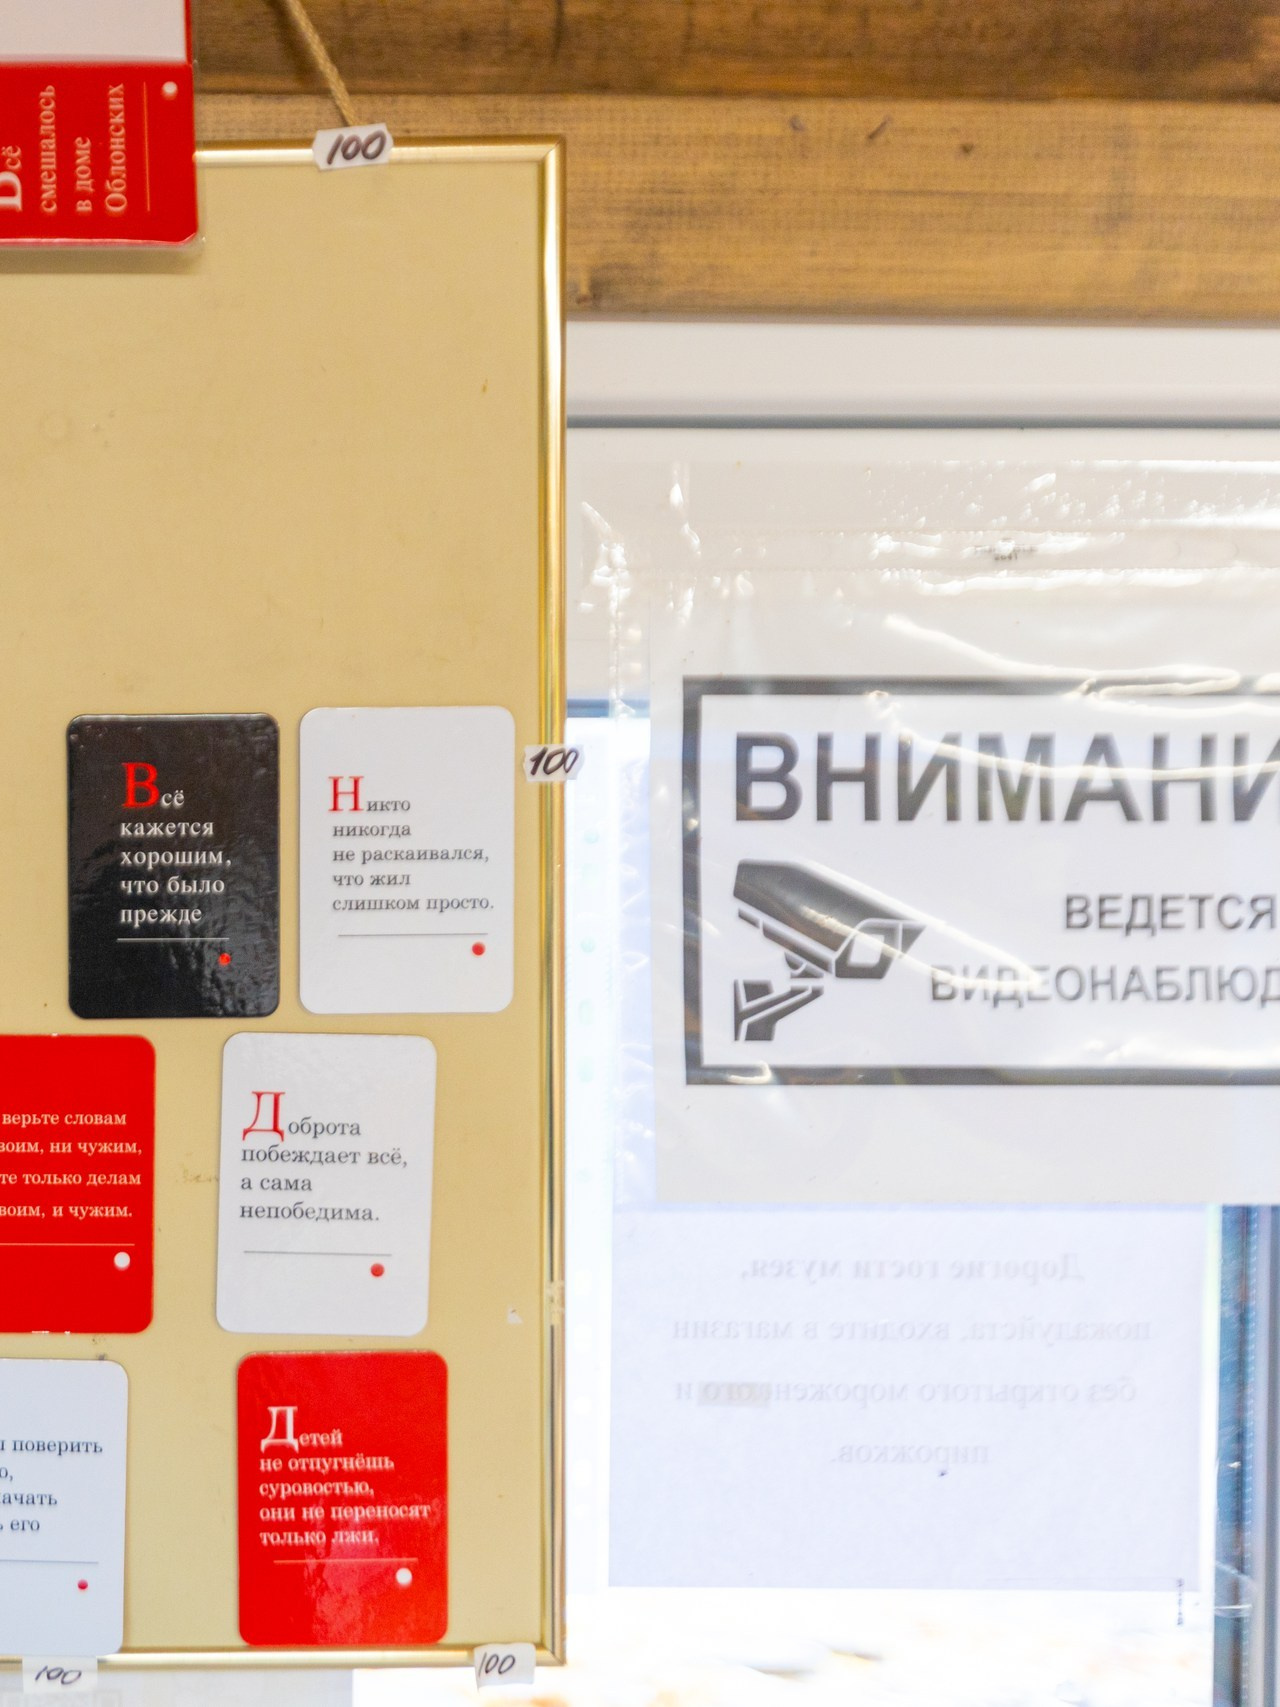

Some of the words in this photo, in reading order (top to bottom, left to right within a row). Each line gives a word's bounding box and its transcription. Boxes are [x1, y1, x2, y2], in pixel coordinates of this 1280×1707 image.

[40, 85, 56, 213] смешалось
[105, 83, 128, 214] Облонских
[327, 130, 386, 165] 100
[75, 136, 92, 193] доме
[76, 199, 92, 213] в
[530, 747, 579, 775] 100
[121, 762, 185, 809] Всё
[328, 776, 411, 812] Никто
[120, 822, 214, 836] кажется
[333, 824, 411, 838] никогда
[120, 851, 232, 870] хорошим,
[333, 851, 355, 861] не
[361, 848, 489, 864] раскаивался,
[121, 879, 159, 893] что
[167, 876, 225, 893] было
[332, 875, 364, 886] что
[370, 874, 411, 885] жил
[332, 899, 419, 911] слишком
[426, 899, 494, 912] просто.
[1065, 894, 1275, 935] ВЕДЕТСЯ
[120, 907, 202, 928] прежде
[2, 1113, 59, 1128] верьте
[65, 1113, 127, 1125] словам
[242, 1091, 361, 1142] Доброта
[50, 1142, 72, 1153] ни
[77, 1142, 142, 1156] чужим,
[241, 1144, 360, 1165] побеждает
[368, 1148, 408, 1168] всё,
[22, 1174, 82, 1185] только
[87, 1174, 142, 1186] делам
[241, 1177, 252, 1190] а
[260, 1177, 312, 1191] сама
[52, 1206, 63, 1217] и
[69, 1206, 133, 1220] чужим.
[240, 1202, 379, 1222] непобедима.
[260, 1406, 343, 1453] Детей
[12, 1439, 103, 1456] поверить
[259, 1458, 282, 1471] не
[288, 1453, 395, 1474] отпугнёшь
[259, 1481, 374, 1499] суровостью,
[259, 1507, 295, 1520] они
[302, 1507, 325, 1519] не
[331, 1504, 431, 1523] переносят
[10, 1519, 40, 1532] его
[259, 1531, 326, 1545] только
[331, 1530, 379, 1544] лжи.
[35, 1665, 82, 1684] 100
[478, 1652, 515, 1678] 100
